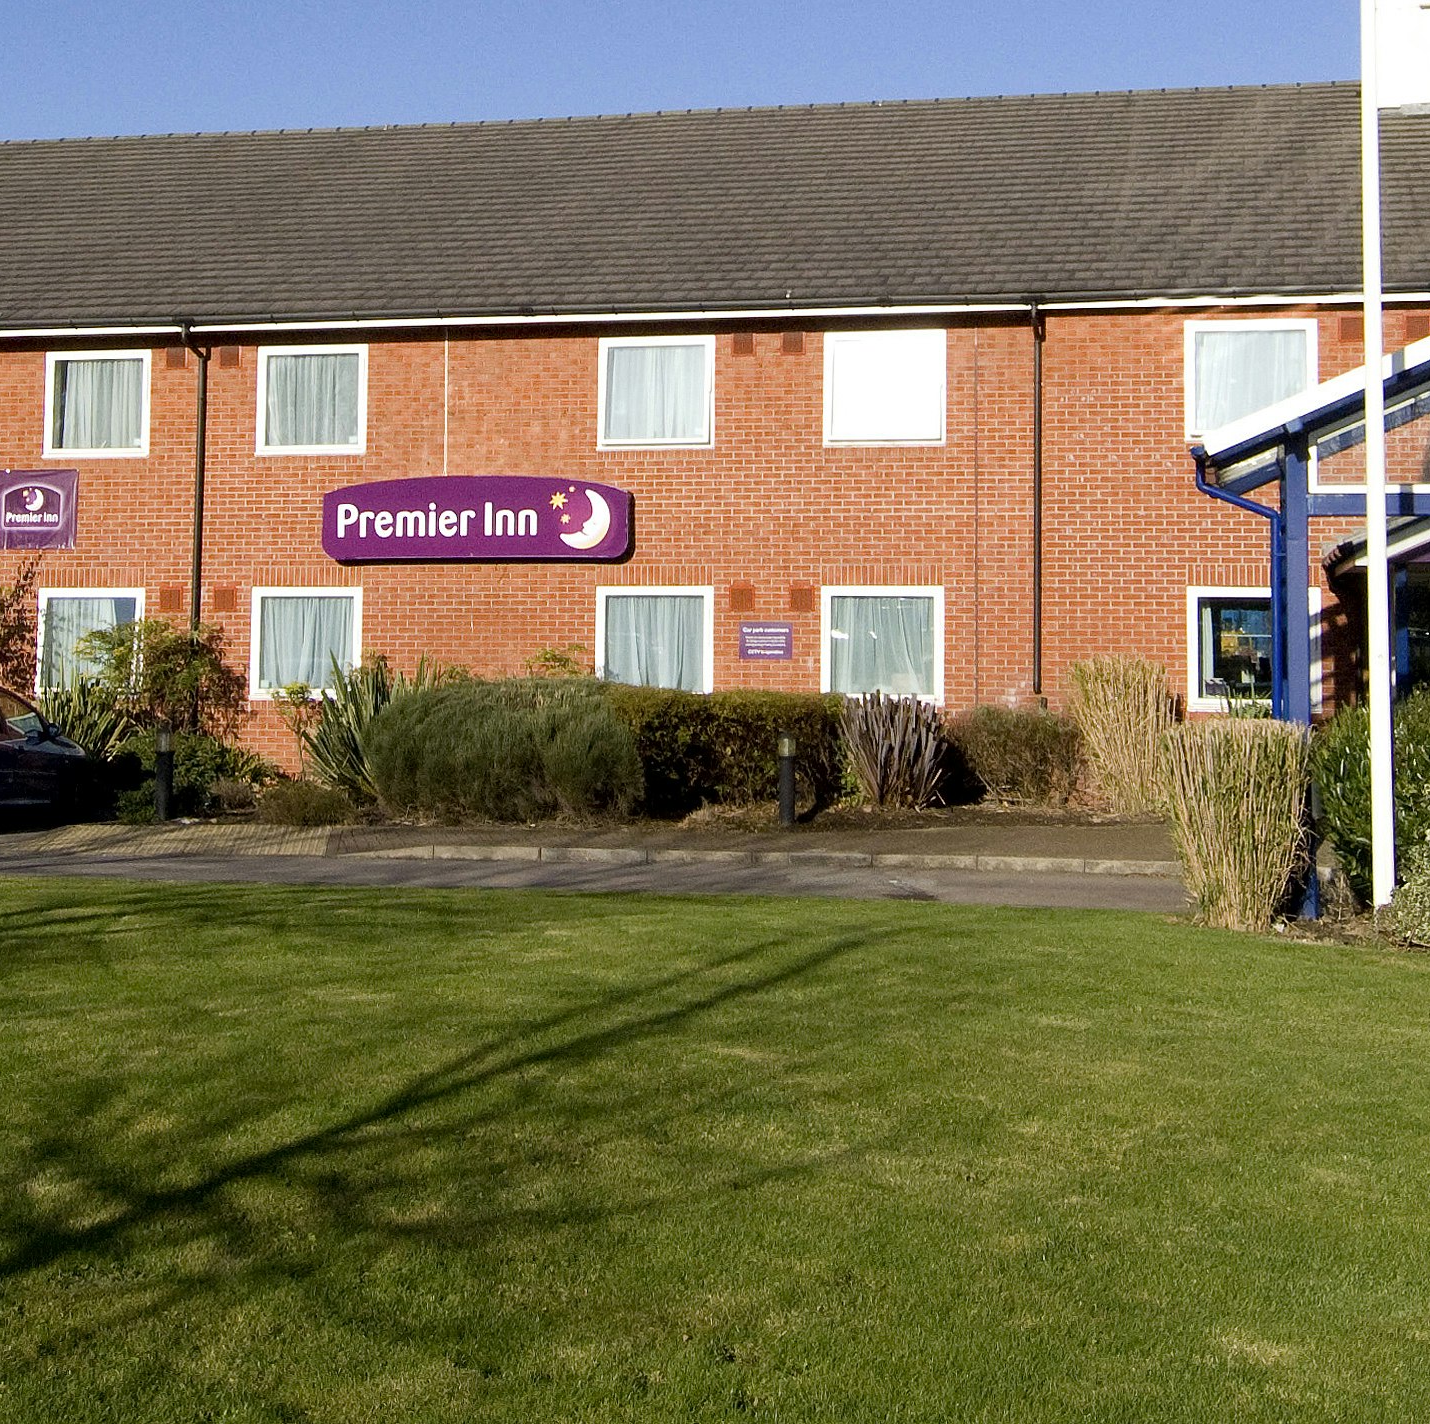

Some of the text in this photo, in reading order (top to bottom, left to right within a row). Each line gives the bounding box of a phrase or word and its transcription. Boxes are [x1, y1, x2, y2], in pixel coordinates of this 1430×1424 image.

[5, 511, 58, 523] Premier Inn
[337, 501, 538, 538] Premier Inn
